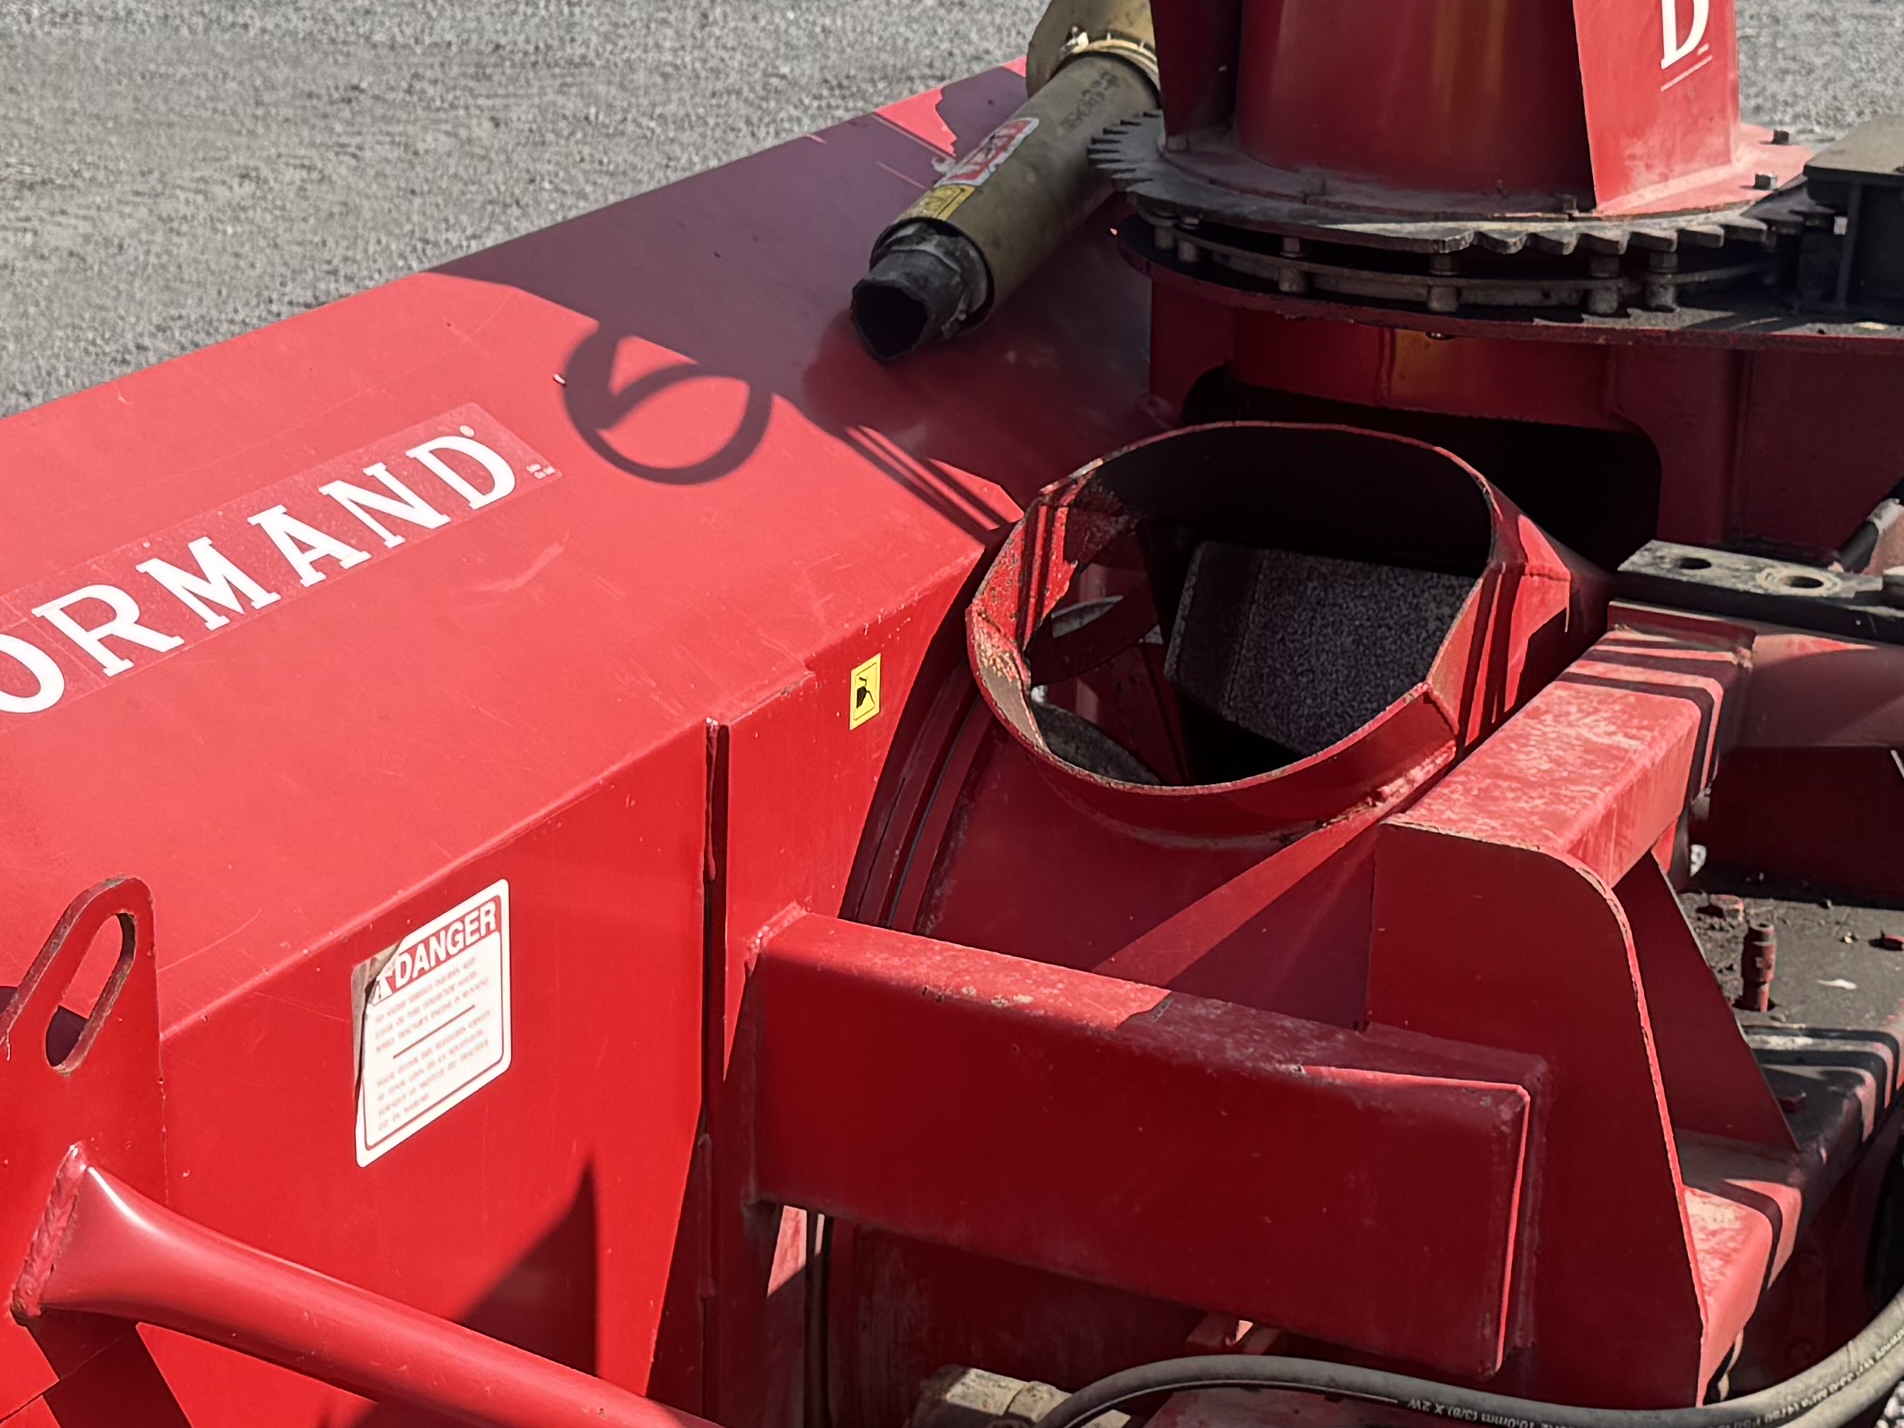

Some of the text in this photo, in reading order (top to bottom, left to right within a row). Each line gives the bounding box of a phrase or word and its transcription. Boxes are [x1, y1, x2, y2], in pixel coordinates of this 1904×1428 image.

[395, 900, 497, 987] DANGER
[1406, 1397, 1431, 1413] 2W
[1433, 1402, 1444, 1415] X
[1446, 1405, 1478, 1424] (3/8)
